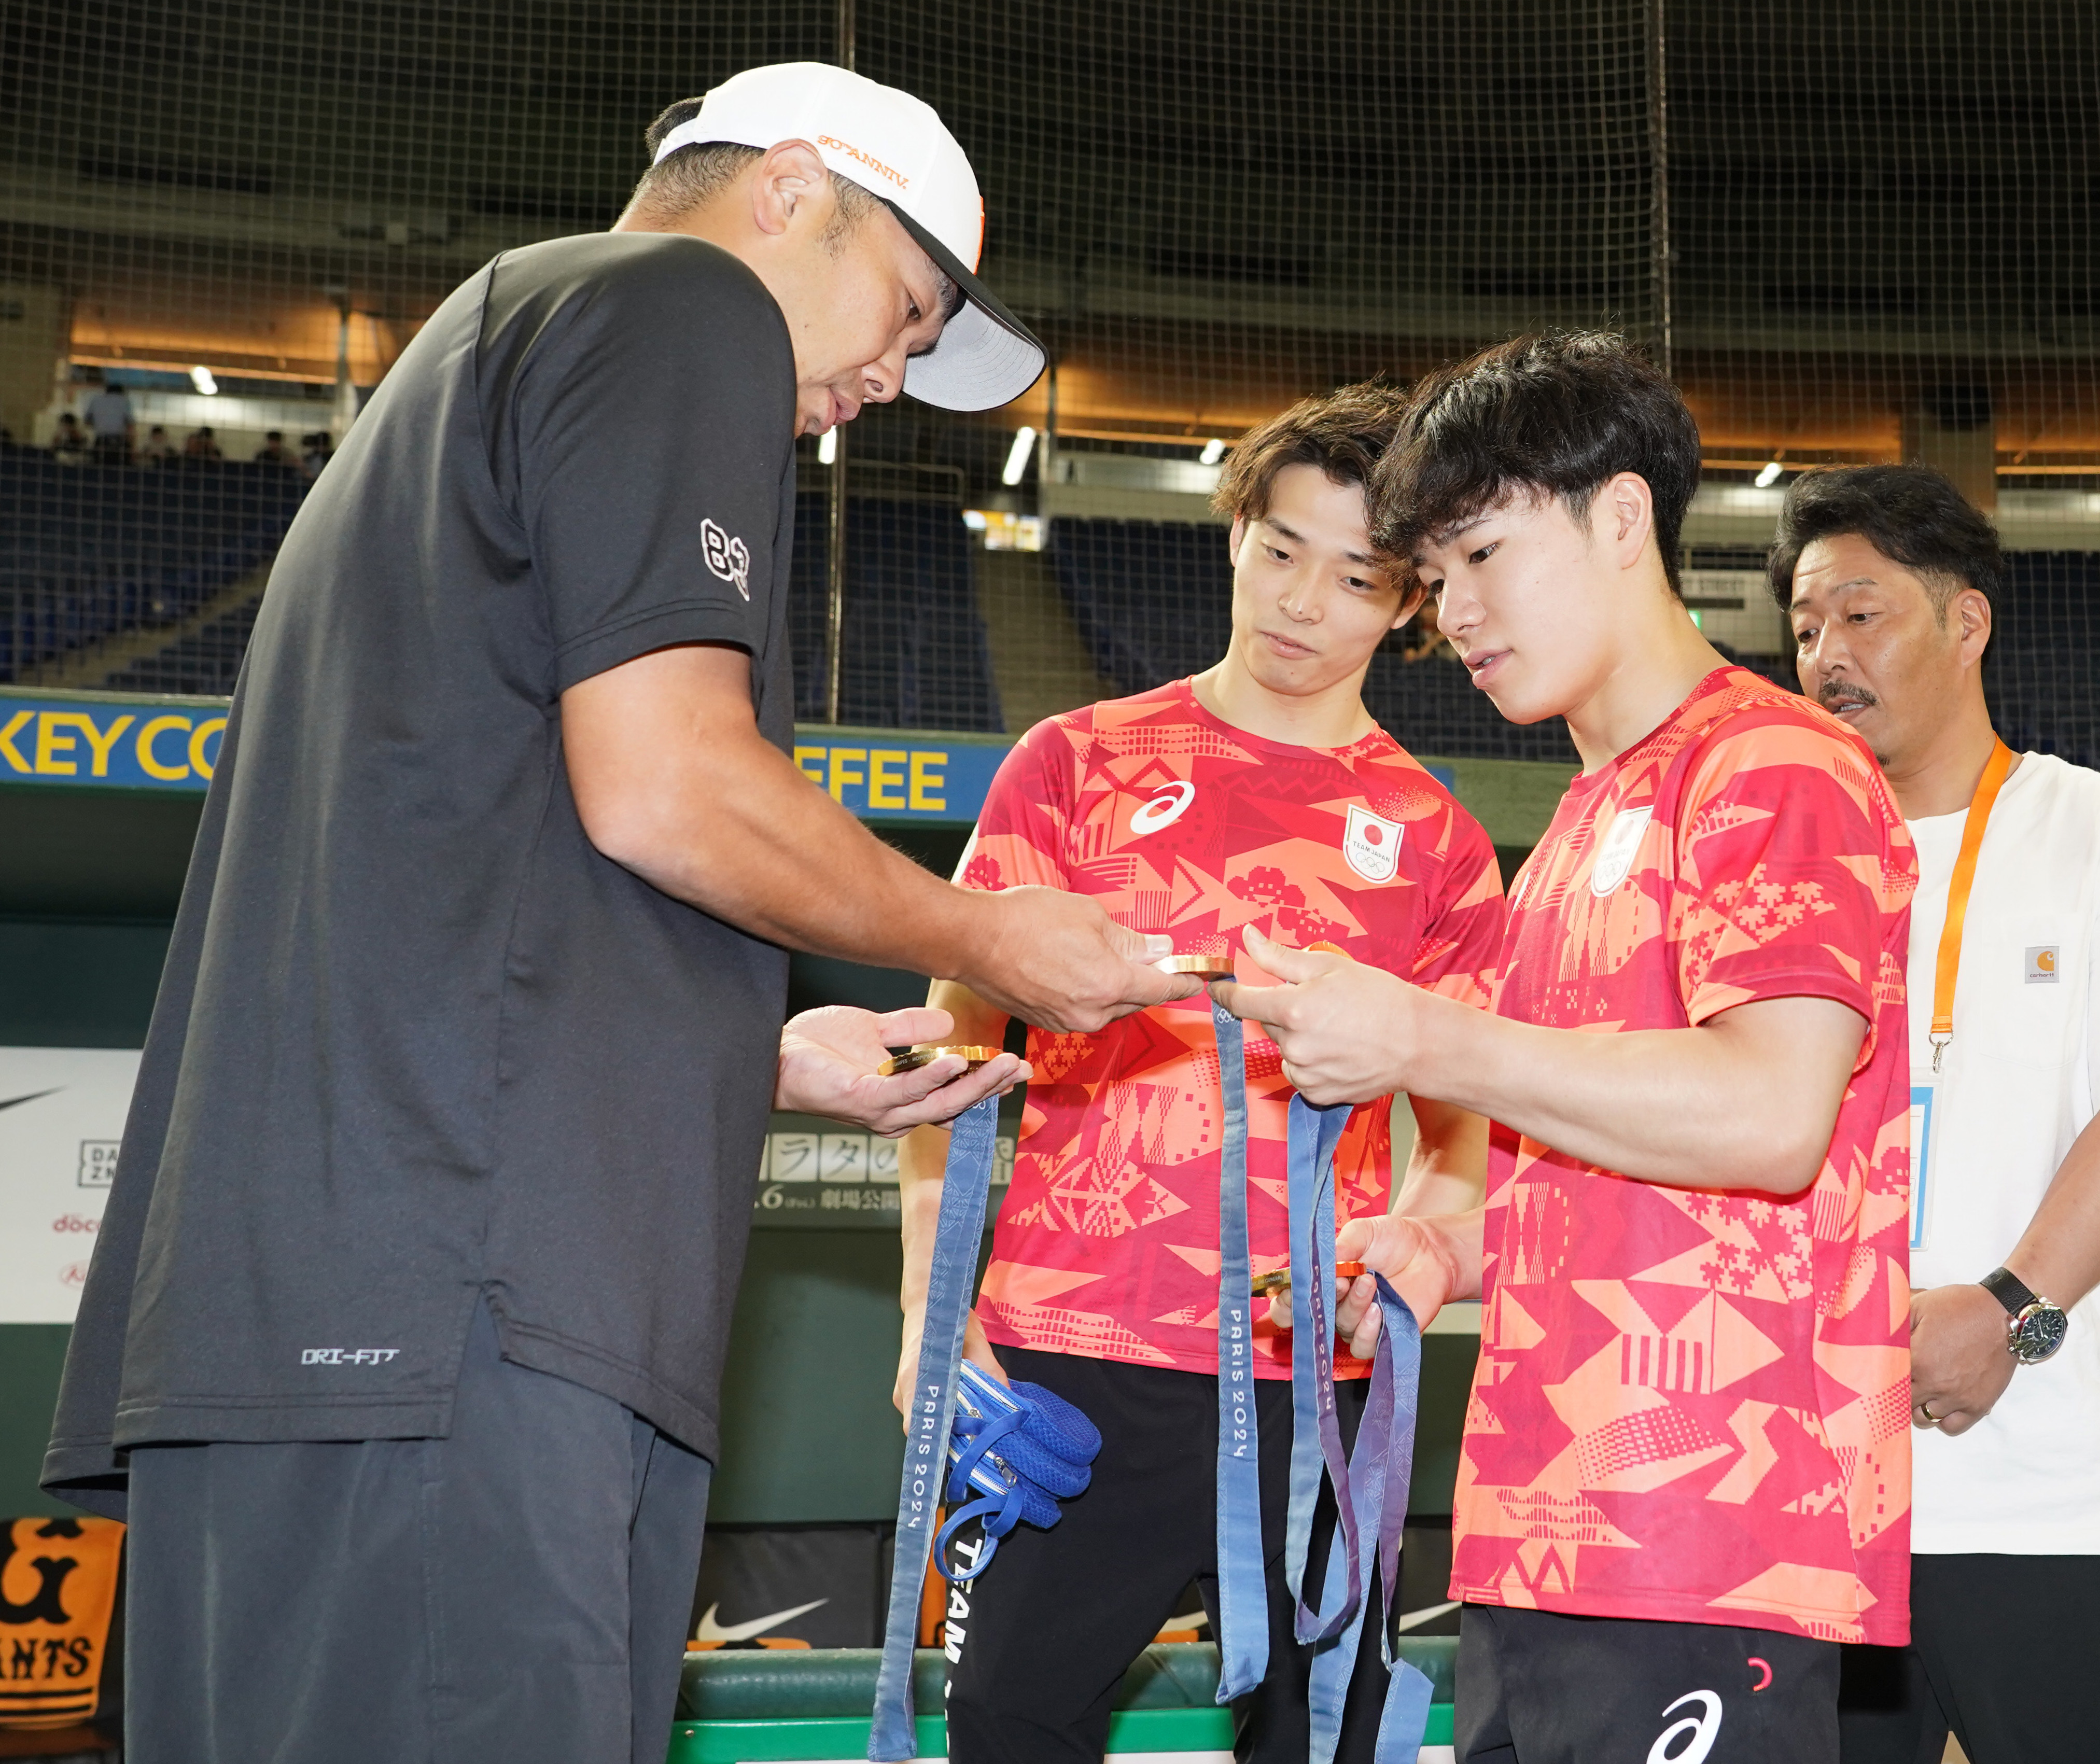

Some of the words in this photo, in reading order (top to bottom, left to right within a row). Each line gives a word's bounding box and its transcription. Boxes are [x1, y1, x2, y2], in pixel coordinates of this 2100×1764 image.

[846, 148, 909, 190] ANNIV.
[0, 710, 136, 777] KEY
[794, 746, 948, 811] FFEE
[1353, 841, 1370, 852] TEAM
[1371, 849, 1390, 862] JAPAN
[53, 1214, 102, 1233] doc
[301, 1348, 401, 1366] DRI-FIT
[1319, 1343, 1332, 1410] 2024
[1233, 1391, 1248, 1457] 2024
[908, 1463, 928, 1528] 2024
[944, 1538, 983, 1664] TEAM
[0, 1636, 92, 1679] NTS
